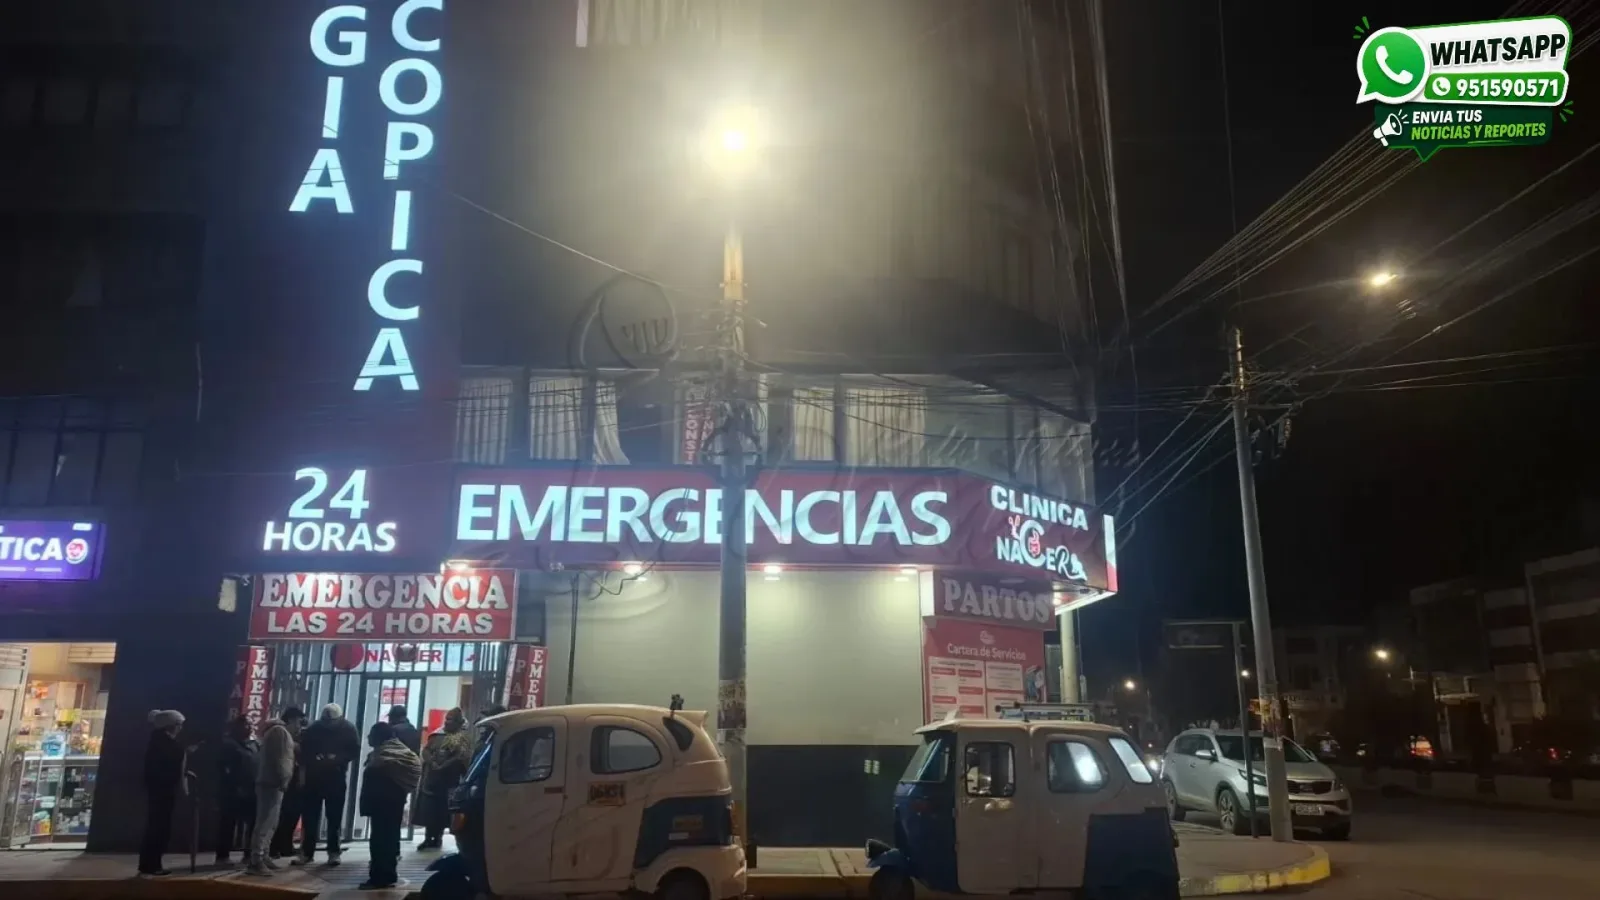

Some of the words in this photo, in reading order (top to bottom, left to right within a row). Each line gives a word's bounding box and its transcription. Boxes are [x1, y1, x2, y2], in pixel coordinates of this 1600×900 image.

[288, 467, 370, 519] 24
[990, 484, 1089, 531] CLINICA
[263, 521, 397, 552] HORAS
[260, 574, 509, 610] EMERGENCIA
[942, 578, 1051, 623] PARTOS
[267, 612, 328, 634] LAS
[338, 612, 374, 634] 24
[385, 612, 493, 635] HORAS
[947, 642, 978, 657] Cartera
[980, 646, 991, 658] de
[992, 647, 1027, 661] Servicios
